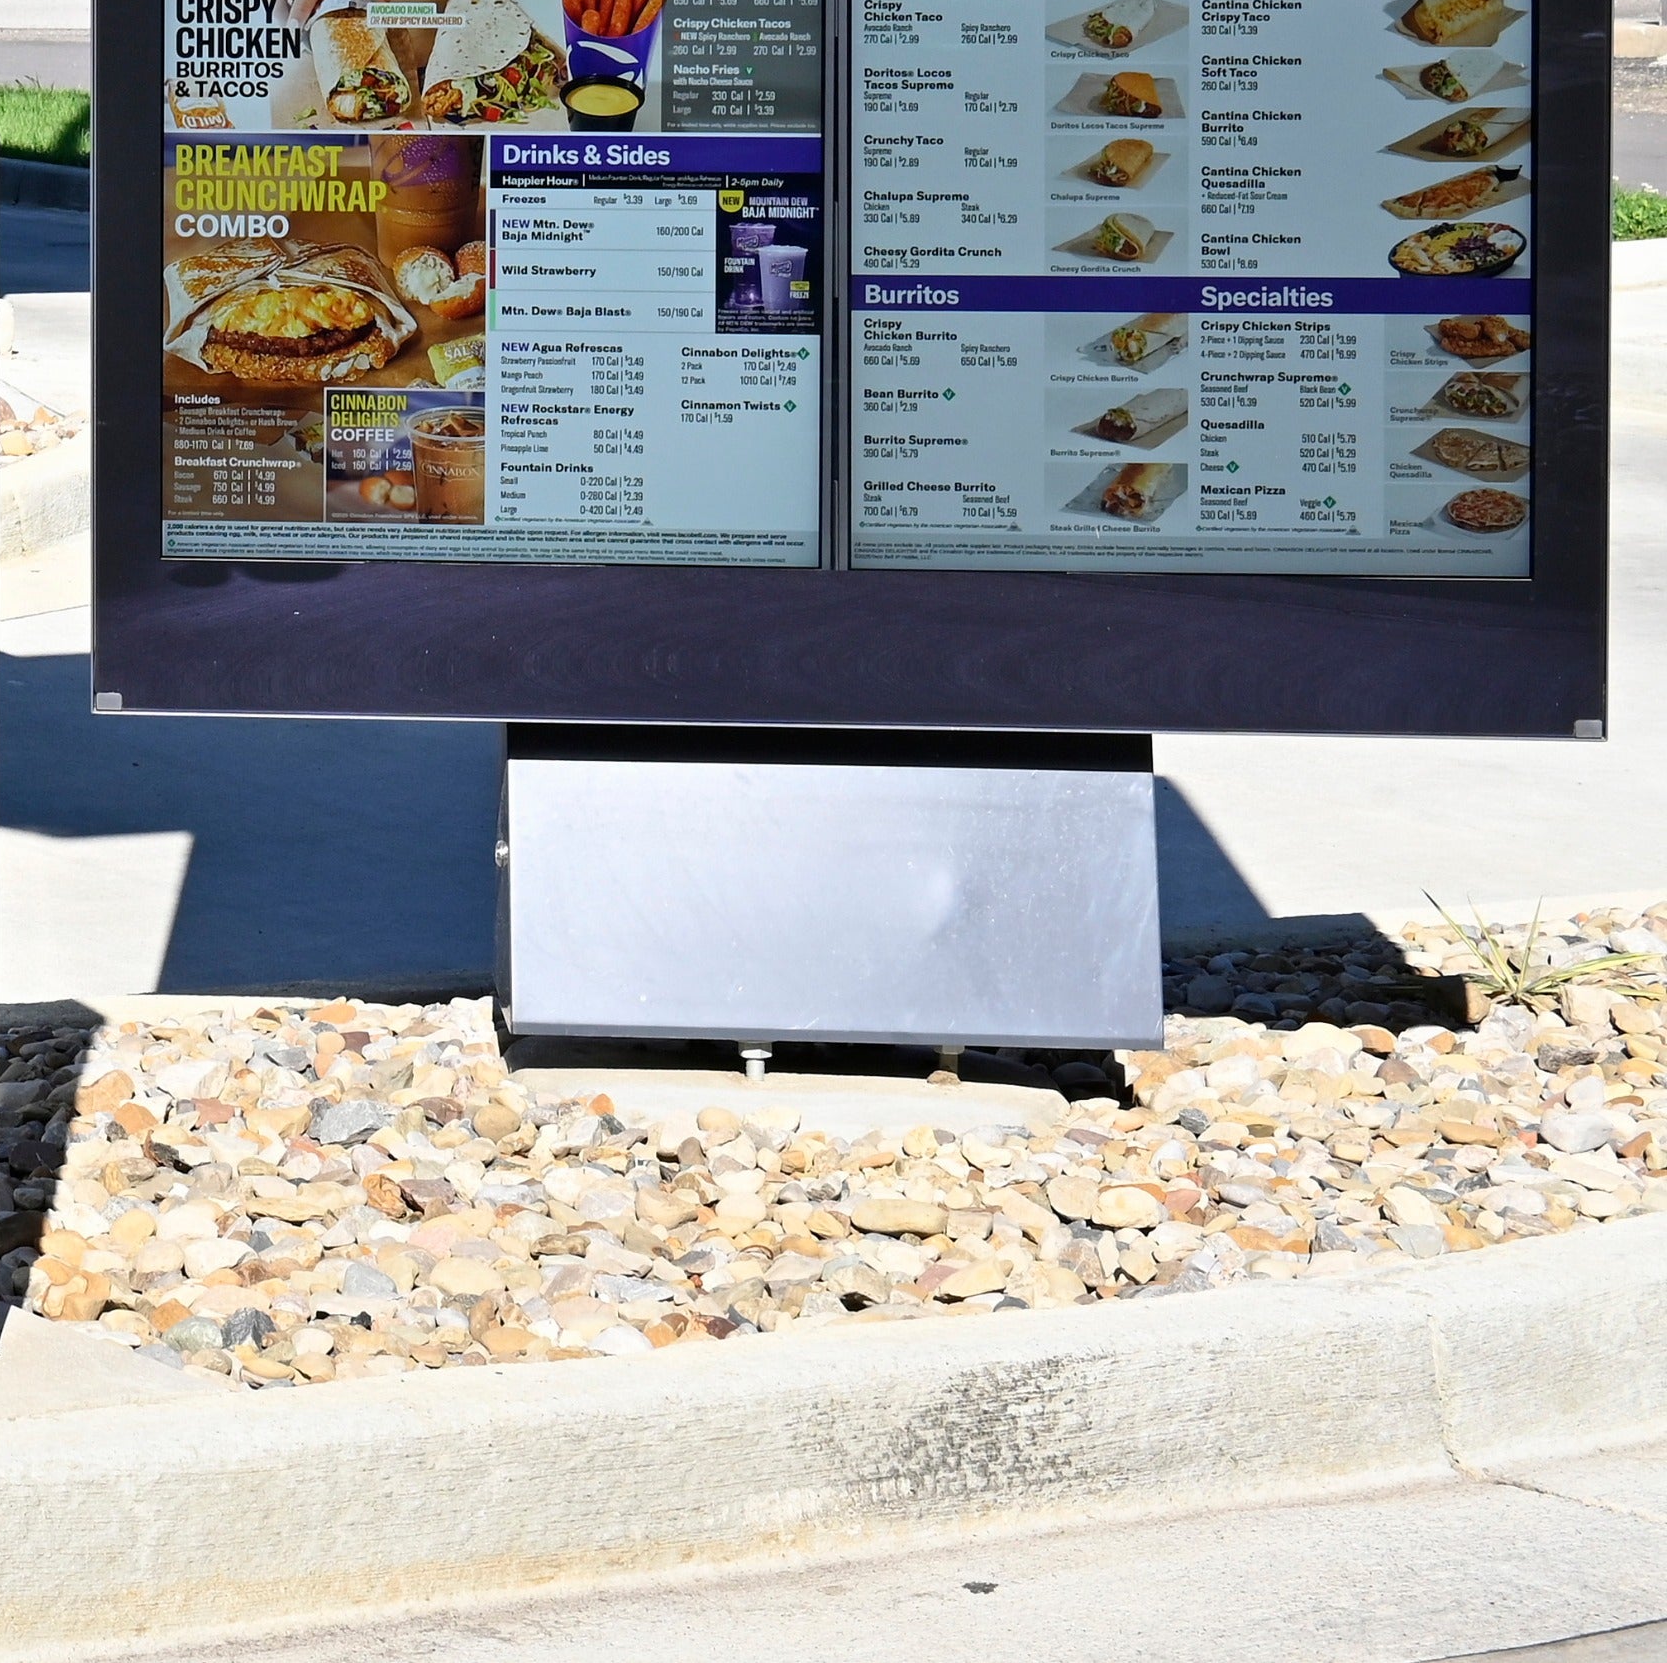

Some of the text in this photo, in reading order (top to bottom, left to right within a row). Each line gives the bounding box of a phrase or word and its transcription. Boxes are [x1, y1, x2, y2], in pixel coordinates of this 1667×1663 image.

[370, 5, 434, 14] AVOCADO RANCH
[370, 16, 462, 25] OR NEW SPICY RANCHERO
[176, 27, 301, 58] CHICKEN
[176, 62, 284, 78] BURRITOS
[175, 82, 269, 98] & TACOS
[174, 145, 343, 177] BREAKFAST
[502, 145, 671, 165] Drinks & Sides
[174, 179, 387, 212] CRUNCHWRAP
[174, 214, 290, 238] COMBO
[502, 266, 596, 278] Wild Strawberry
[657, 267, 703, 277] 150/190 Cal
[865, 285, 959, 305] Burritos
[1201, 286, 1334, 310] Specialties
[501, 343, 623, 355] NEW Agua Refrescas
[175, 394, 220, 405] Includes
[330, 394, 407, 411] CINNABON
[681, 400, 781, 411] Cinnamon Twists
[330, 412, 399, 427] DELIGHTS
[330, 428, 395, 442] COFFEE
[1200, 485, 1286, 496] Mexican Pizza
